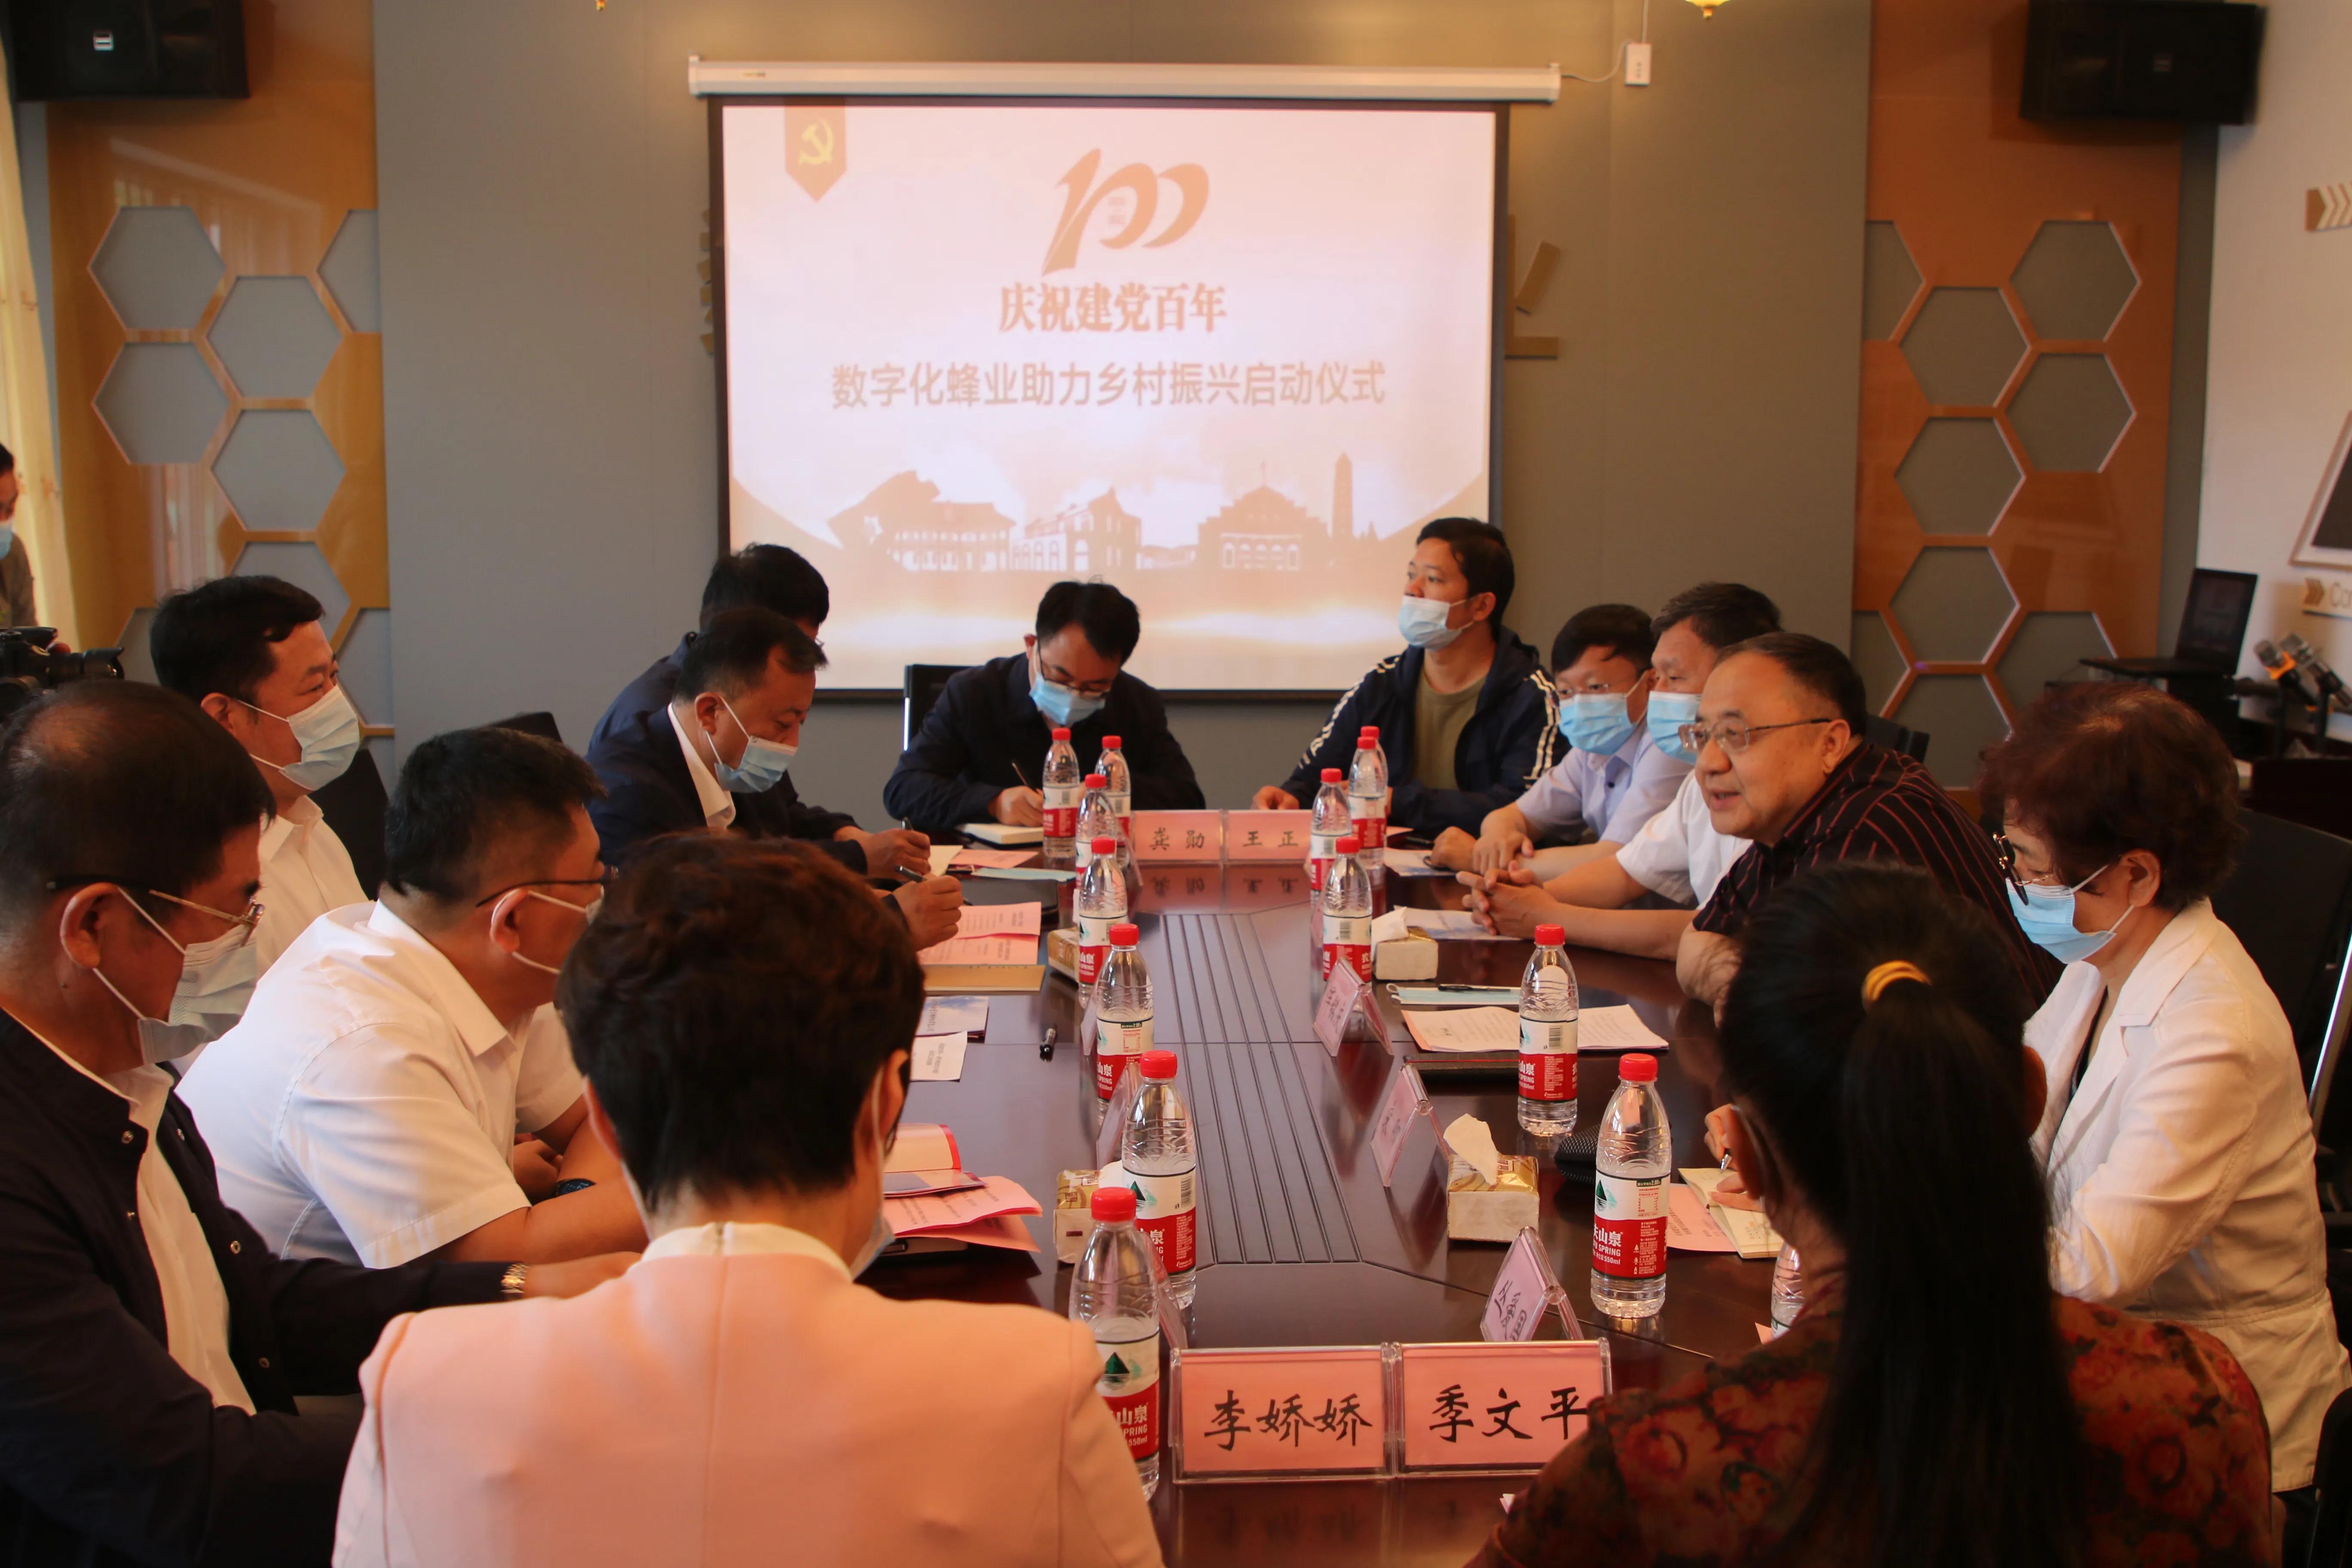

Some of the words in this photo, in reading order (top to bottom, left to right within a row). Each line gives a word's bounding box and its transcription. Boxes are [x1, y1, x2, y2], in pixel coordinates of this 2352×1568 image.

[999, 282, 1227, 332] 庆祝建党百年
[832, 360, 1386, 409] 数字化蜂业助力乡村振兴启动仪式
[1519, 1060, 1534, 1076] 山泉
[1599, 1243, 1621, 1257] SPRING
[1116, 1404, 1148, 1426] 山泉
[1204, 1390, 1373, 1452] 李娇娇
[1429, 1384, 1587, 1443] 季文平
[1123, 1424, 1148, 1437] PRING
[1129, 1435, 1148, 1447] 550ml
